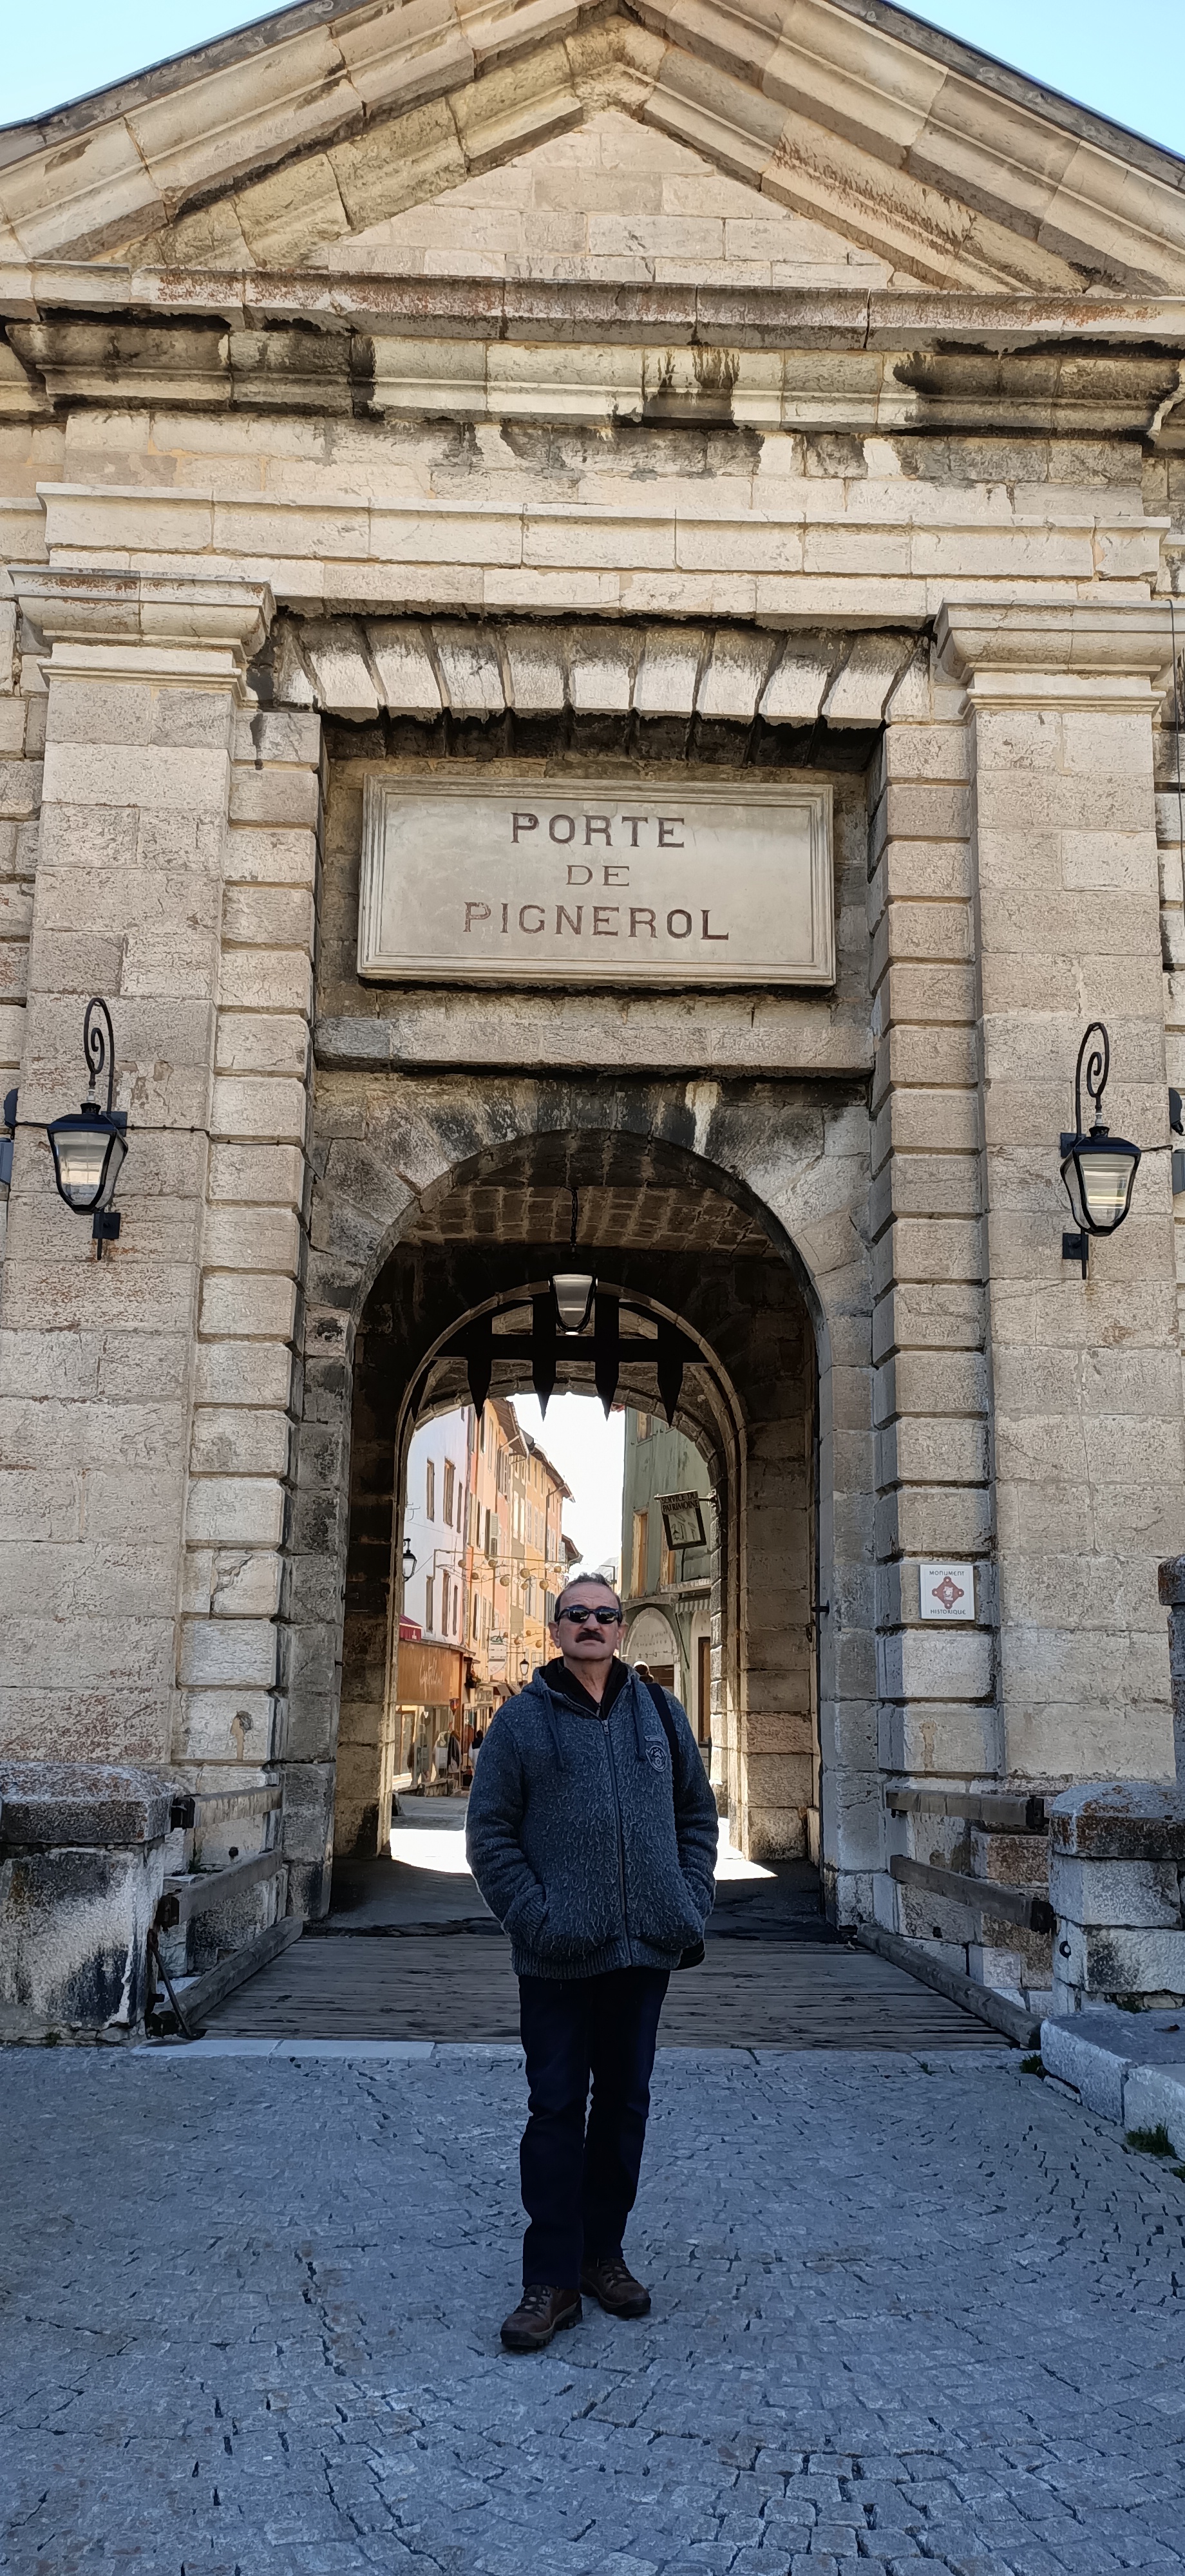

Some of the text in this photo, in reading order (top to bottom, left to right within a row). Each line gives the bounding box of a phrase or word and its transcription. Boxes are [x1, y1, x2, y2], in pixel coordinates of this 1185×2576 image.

[510, 811, 685, 848] PORTE
[565, 864, 630, 887] DE
[462, 901, 730, 941] PIGNEROL
[661, 1495, 685, 1504] SERVICE
[662, 1499, 699, 1512] PATRIMOINE
